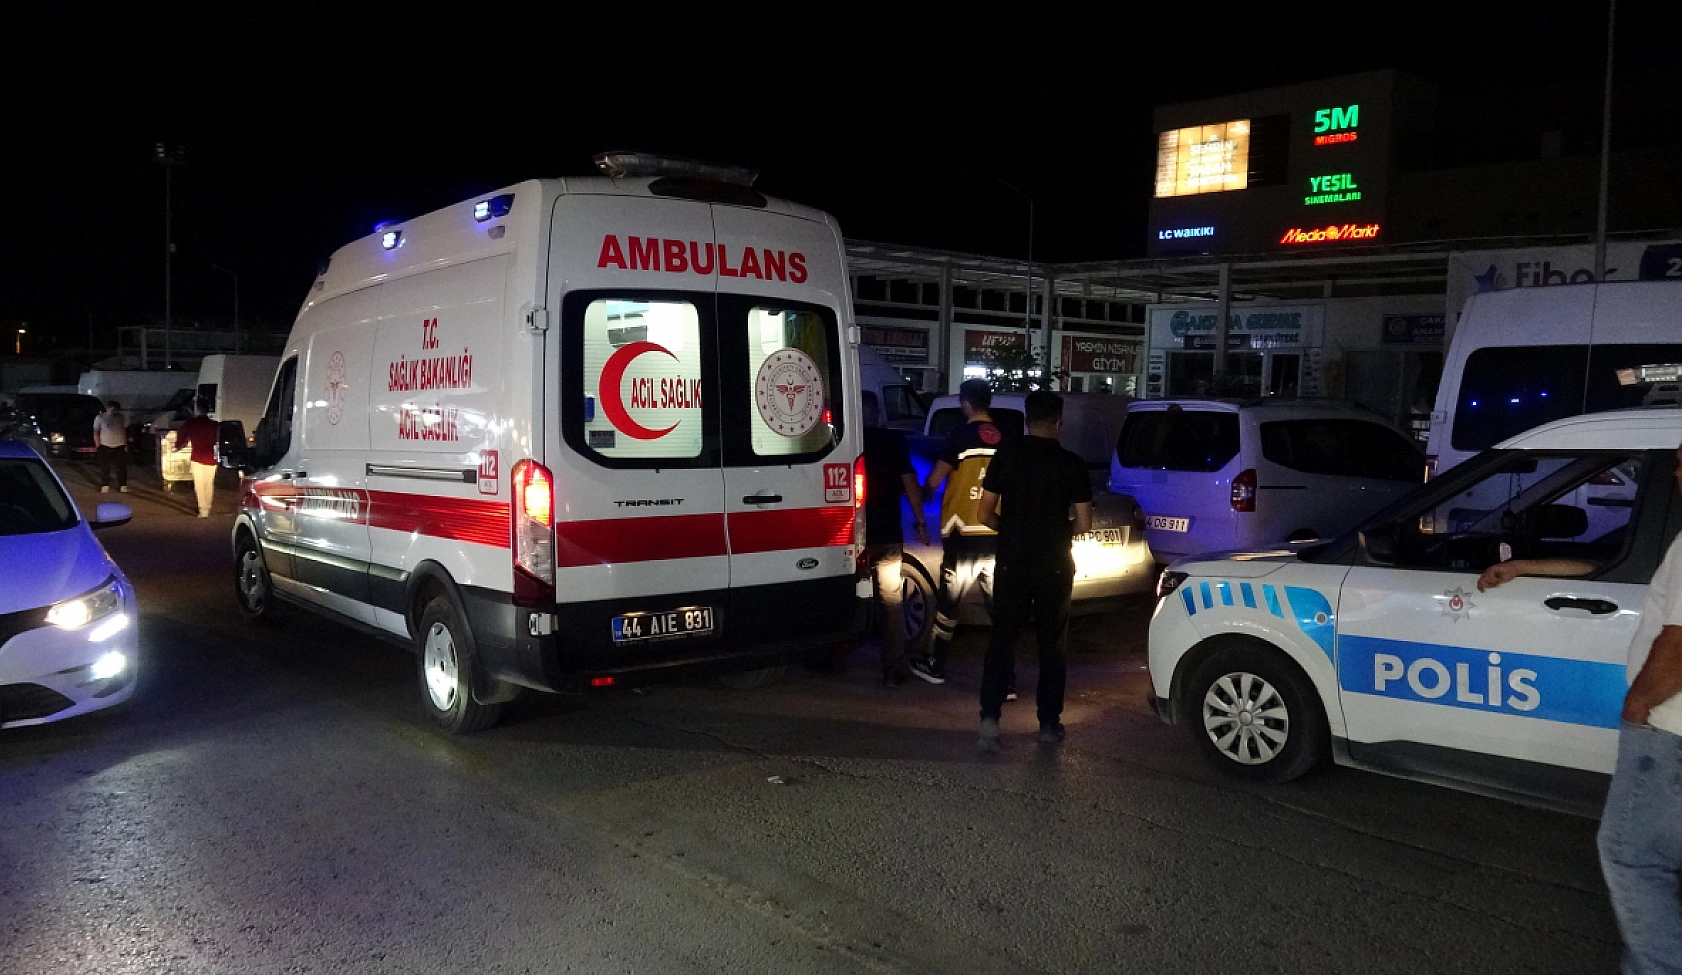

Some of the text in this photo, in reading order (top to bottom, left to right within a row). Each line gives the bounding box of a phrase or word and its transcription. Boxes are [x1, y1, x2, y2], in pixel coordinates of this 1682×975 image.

[1314, 104, 1359, 133] 5M
[1158, 229, 1173, 240] LC
[596, 233, 808, 284] AMBULANS
[422, 317, 440, 350] T.C.
[388, 354, 419, 392] SAĞLIK
[420, 346, 474, 390] BAKANLIĞI
[660, 374, 702, 409] SAĞLIK
[481, 454, 496, 477] 112
[827, 466, 847, 487] 112
[613, 498, 685, 508] TRANSIT
[623, 617, 642, 637] 44
[650, 613, 678, 635] AIE
[684, 609, 711, 629] 831
[1373, 651, 1541, 712] POLİS
